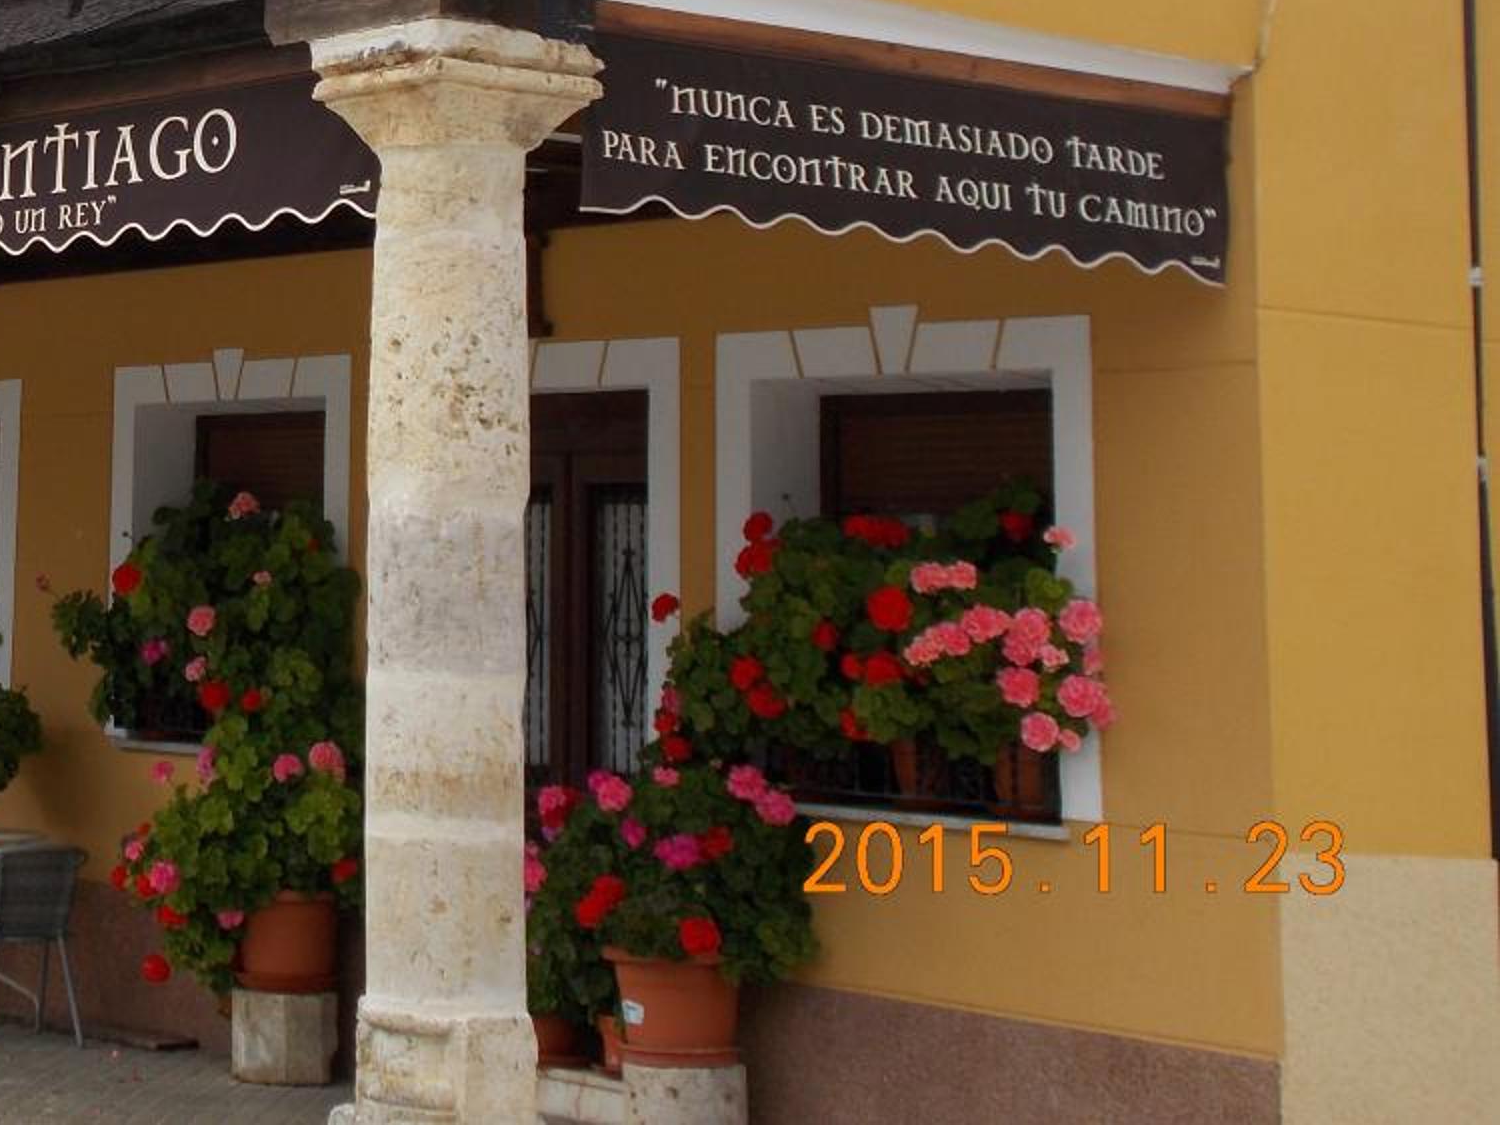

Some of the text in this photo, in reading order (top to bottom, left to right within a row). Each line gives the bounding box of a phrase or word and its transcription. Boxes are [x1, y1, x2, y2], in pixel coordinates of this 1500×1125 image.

[601, 129, 686, 171] PARA
[703, 143, 918, 201] ENCONTRAR
[935, 176, 1012, 212] AQUI
[1024, 183, 1067, 219] TU
[809, 104, 846, 136] ES
[860, 111, 1054, 165] DEMASIADO
[1066, 135, 1166, 181] TARDE
[14, 206, 47, 234] UN
